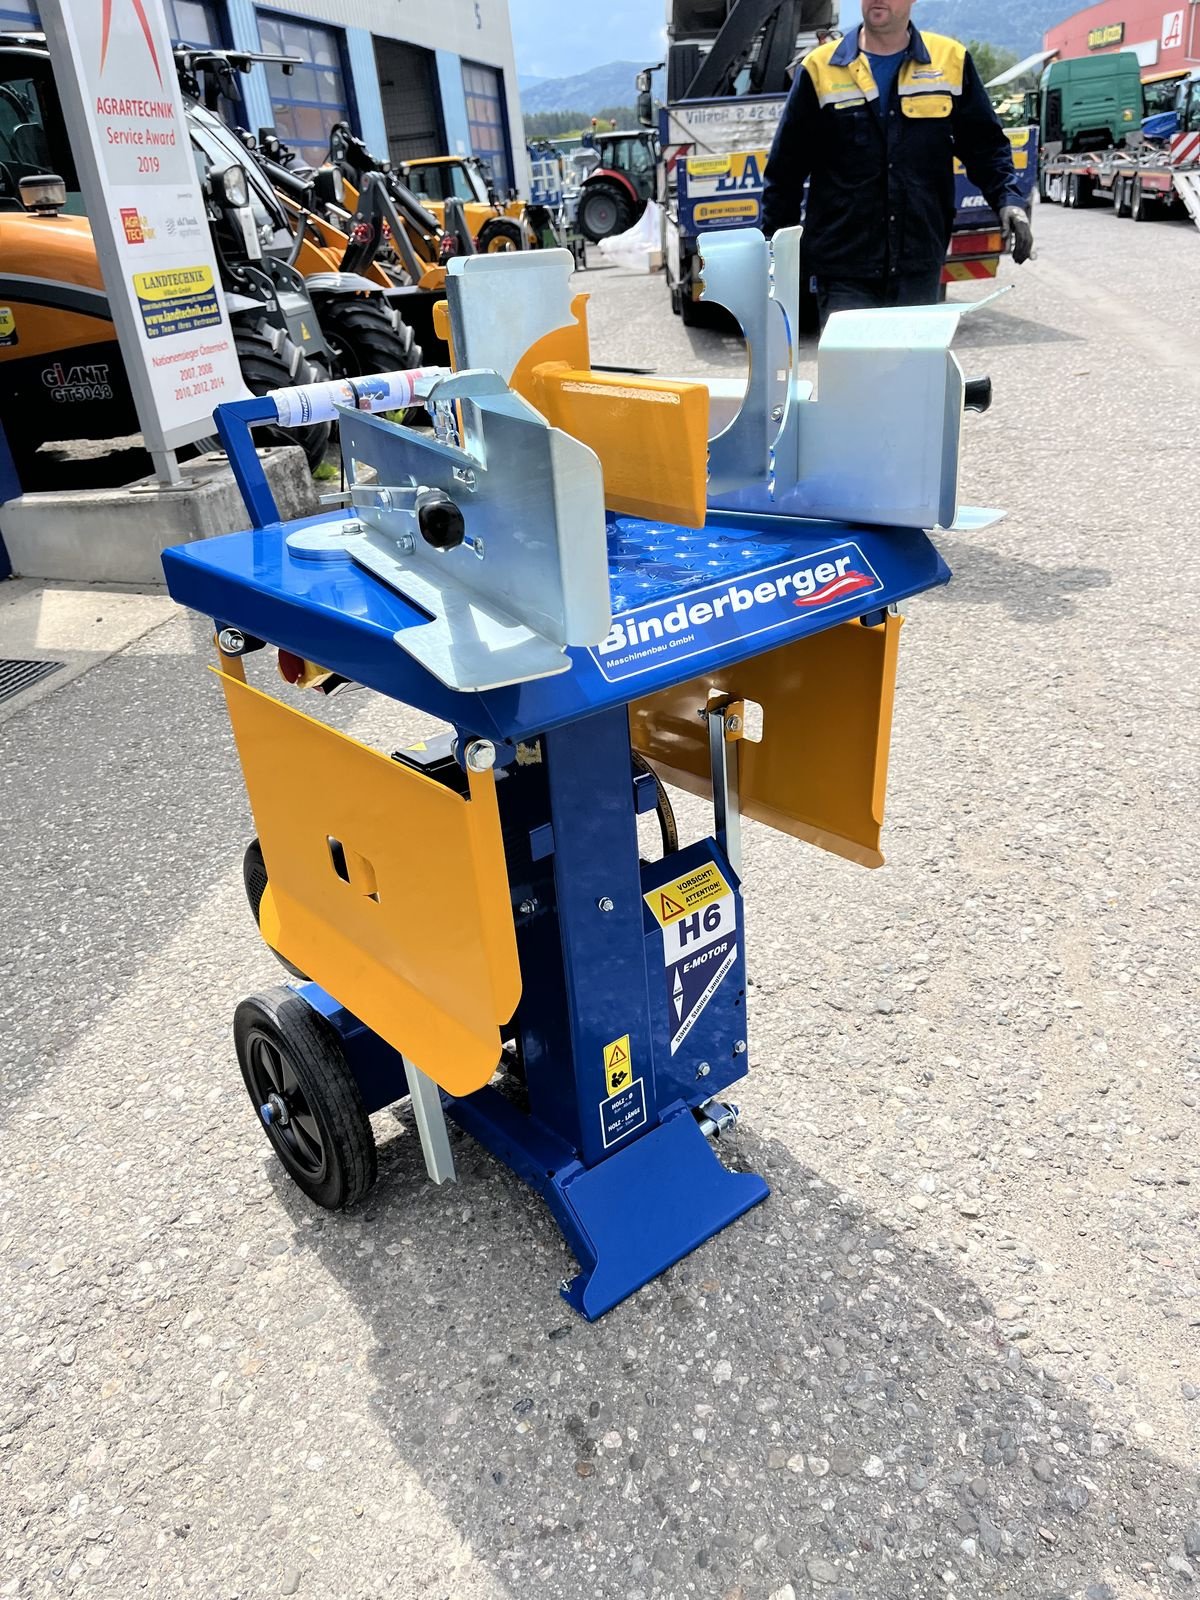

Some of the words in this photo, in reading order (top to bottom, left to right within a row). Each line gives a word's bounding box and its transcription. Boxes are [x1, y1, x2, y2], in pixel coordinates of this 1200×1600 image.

[97, 97, 175, 119] AGRARTECHNIK
[107, 127, 143, 145] Service
[146, 130, 176, 146] Award
[137, 156, 160, 173] 2019
[142, 271, 205, 290] LANDTECHNIK
[144, 303, 219, 326] www.landtechnik.co.at
[51, 384, 113, 403] GT5048
[210, 376, 225, 390] 2014
[598, 555, 851, 656] Binderberger
[606, 643, 668, 669] Maschinenbau
[669, 633, 695, 648] GmbH
[676, 869, 714, 891] VORSICHT!
[685, 880, 721, 903] ATTENTION!
[678, 903, 722, 948] H6
[683, 942, 728, 974] E-MOTOR
[675, 1019, 693, 1043] Stärker.
[691, 994, 710, 1019] Stabiler.
[707, 958, 733, 994] Langlebiger.
[611, 1097, 625, 1110] HOLZ
[608, 1119, 621, 1132] HOLZ
[625, 1106, 641, 1121] LÄNGE
